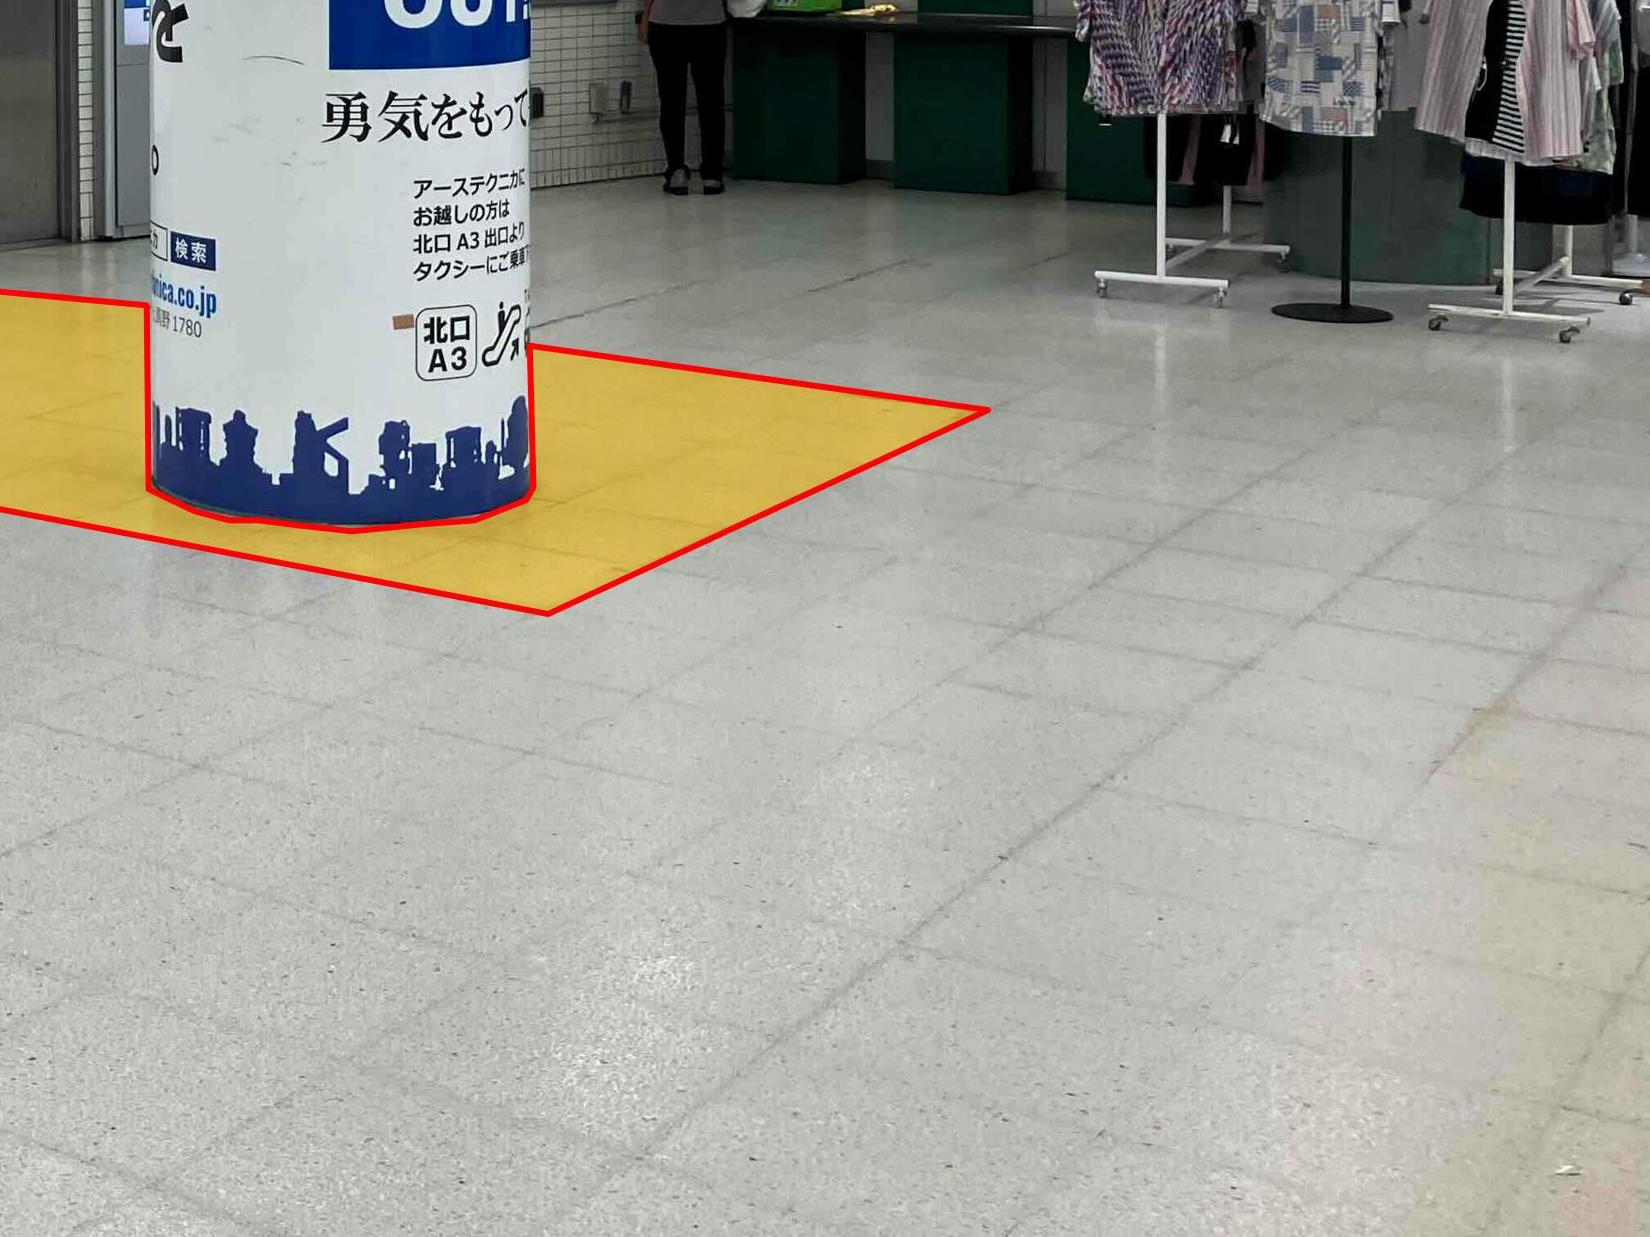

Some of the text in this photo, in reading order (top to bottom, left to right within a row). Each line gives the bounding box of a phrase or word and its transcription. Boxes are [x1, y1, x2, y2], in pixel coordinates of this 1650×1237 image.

[321, 89, 528, 144] 勇気をもって
[413, 168, 526, 199] アーステクニカに
[413, 199, 510, 228] お越しの方は
[175, 237, 207, 264] 検索
[413, 221, 525, 255] 北口 A3 出口より
[173, 314, 203, 339] 1780
[423, 316, 470, 345] 北口
[428, 346, 468, 374] A3
